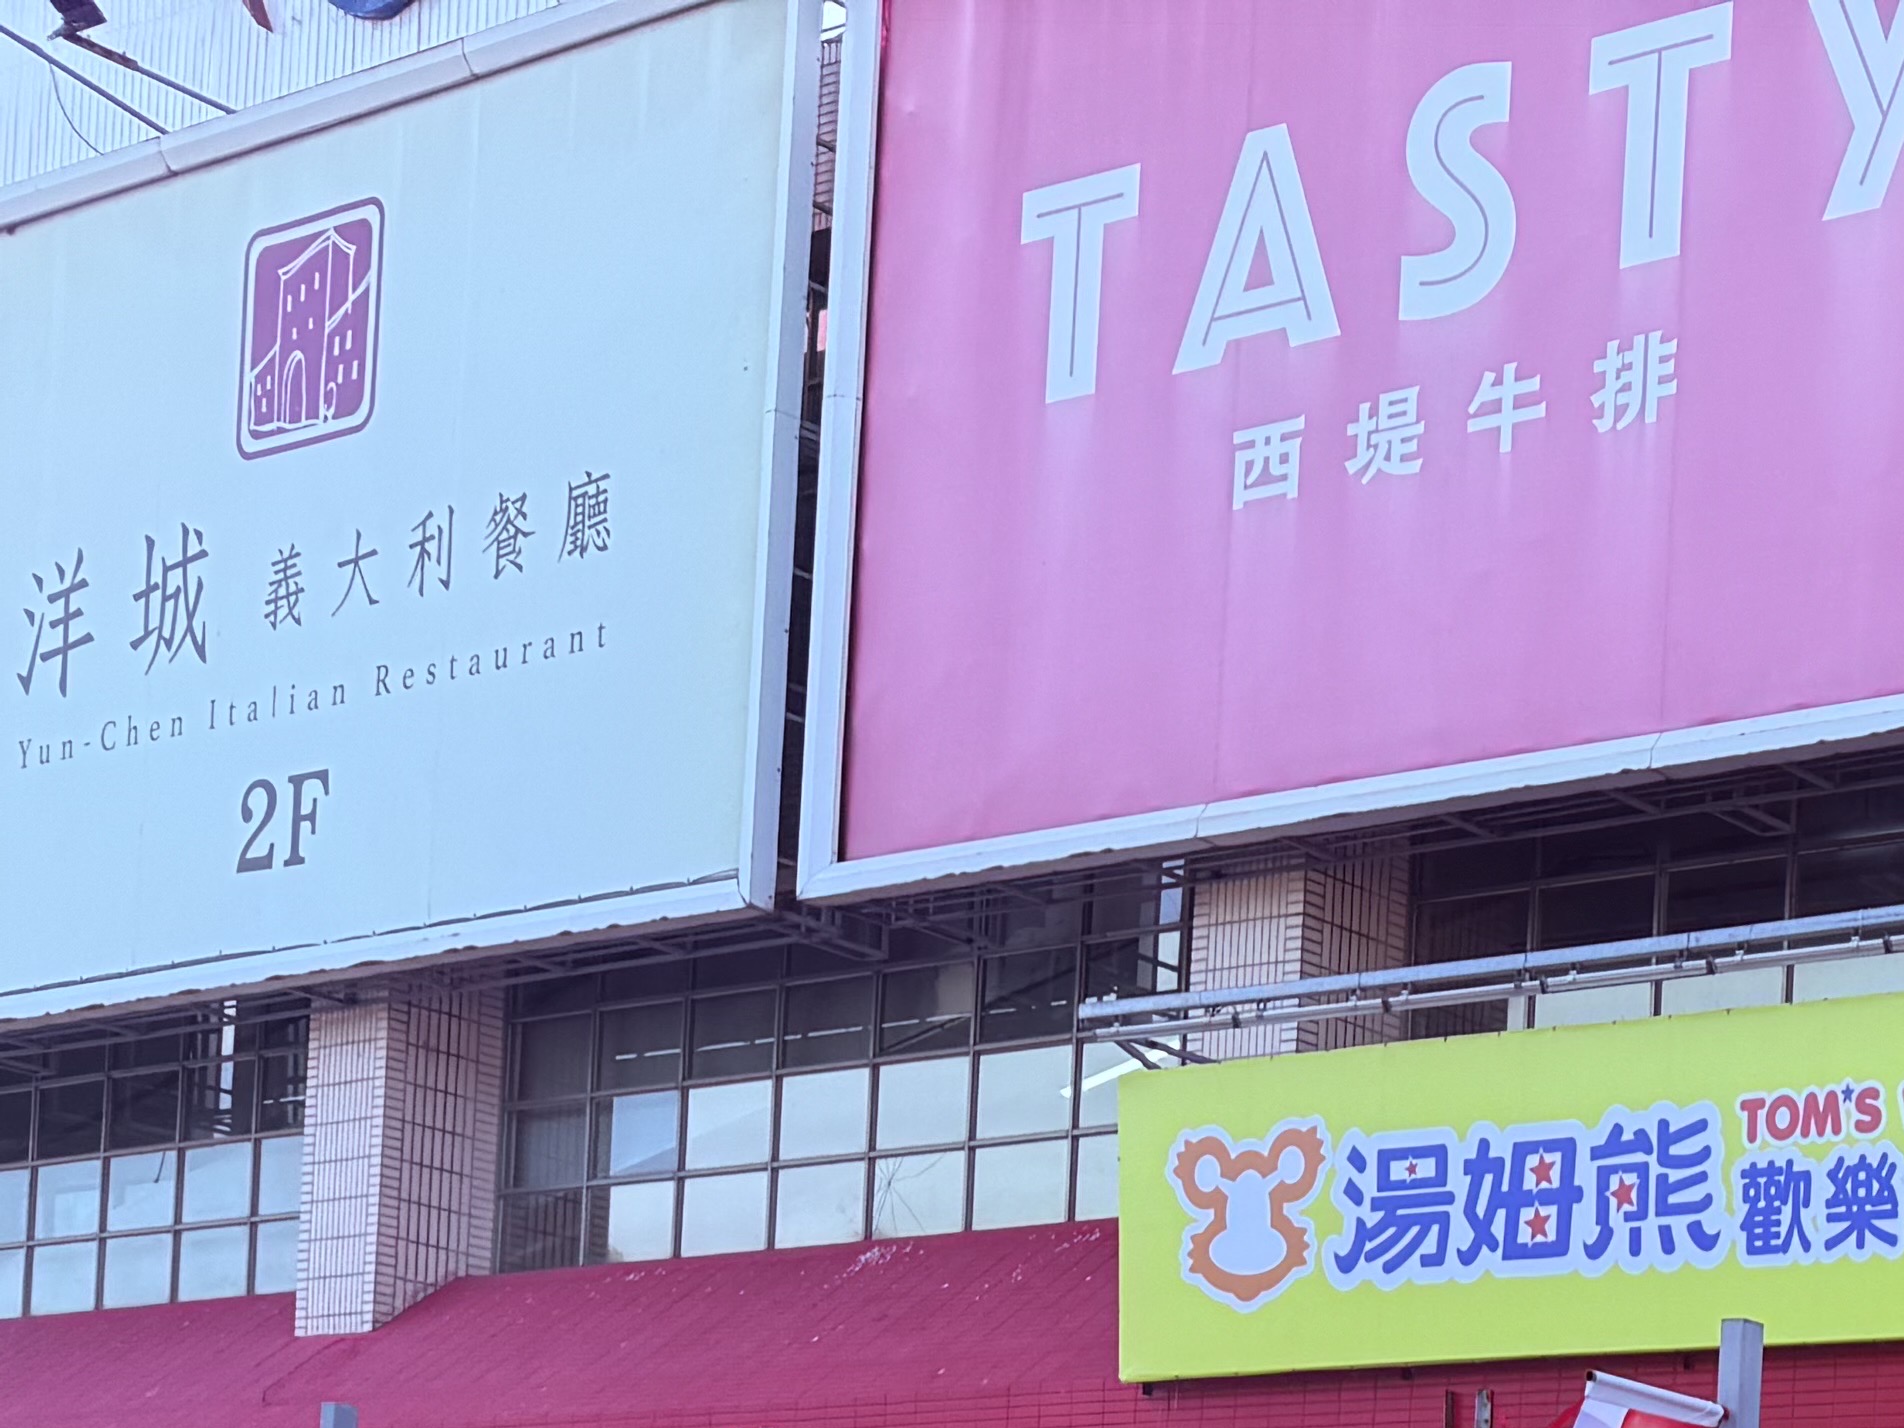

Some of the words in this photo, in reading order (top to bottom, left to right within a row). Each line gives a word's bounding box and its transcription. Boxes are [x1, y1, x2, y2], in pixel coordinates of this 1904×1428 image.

[1231, 332, 1679, 510] 西堤牛排
[17, 522, 210, 698] 洋城
[263, 469, 613, 631] 義大利餐廳
[17, 708, 187, 770] Yun-Chen
[208, 678, 347, 733] Italian
[373, 621, 609, 698] Restaurant
[236, 768, 331, 874] 2F
[1333, 1116, 1722, 1275] 湯姆熊
